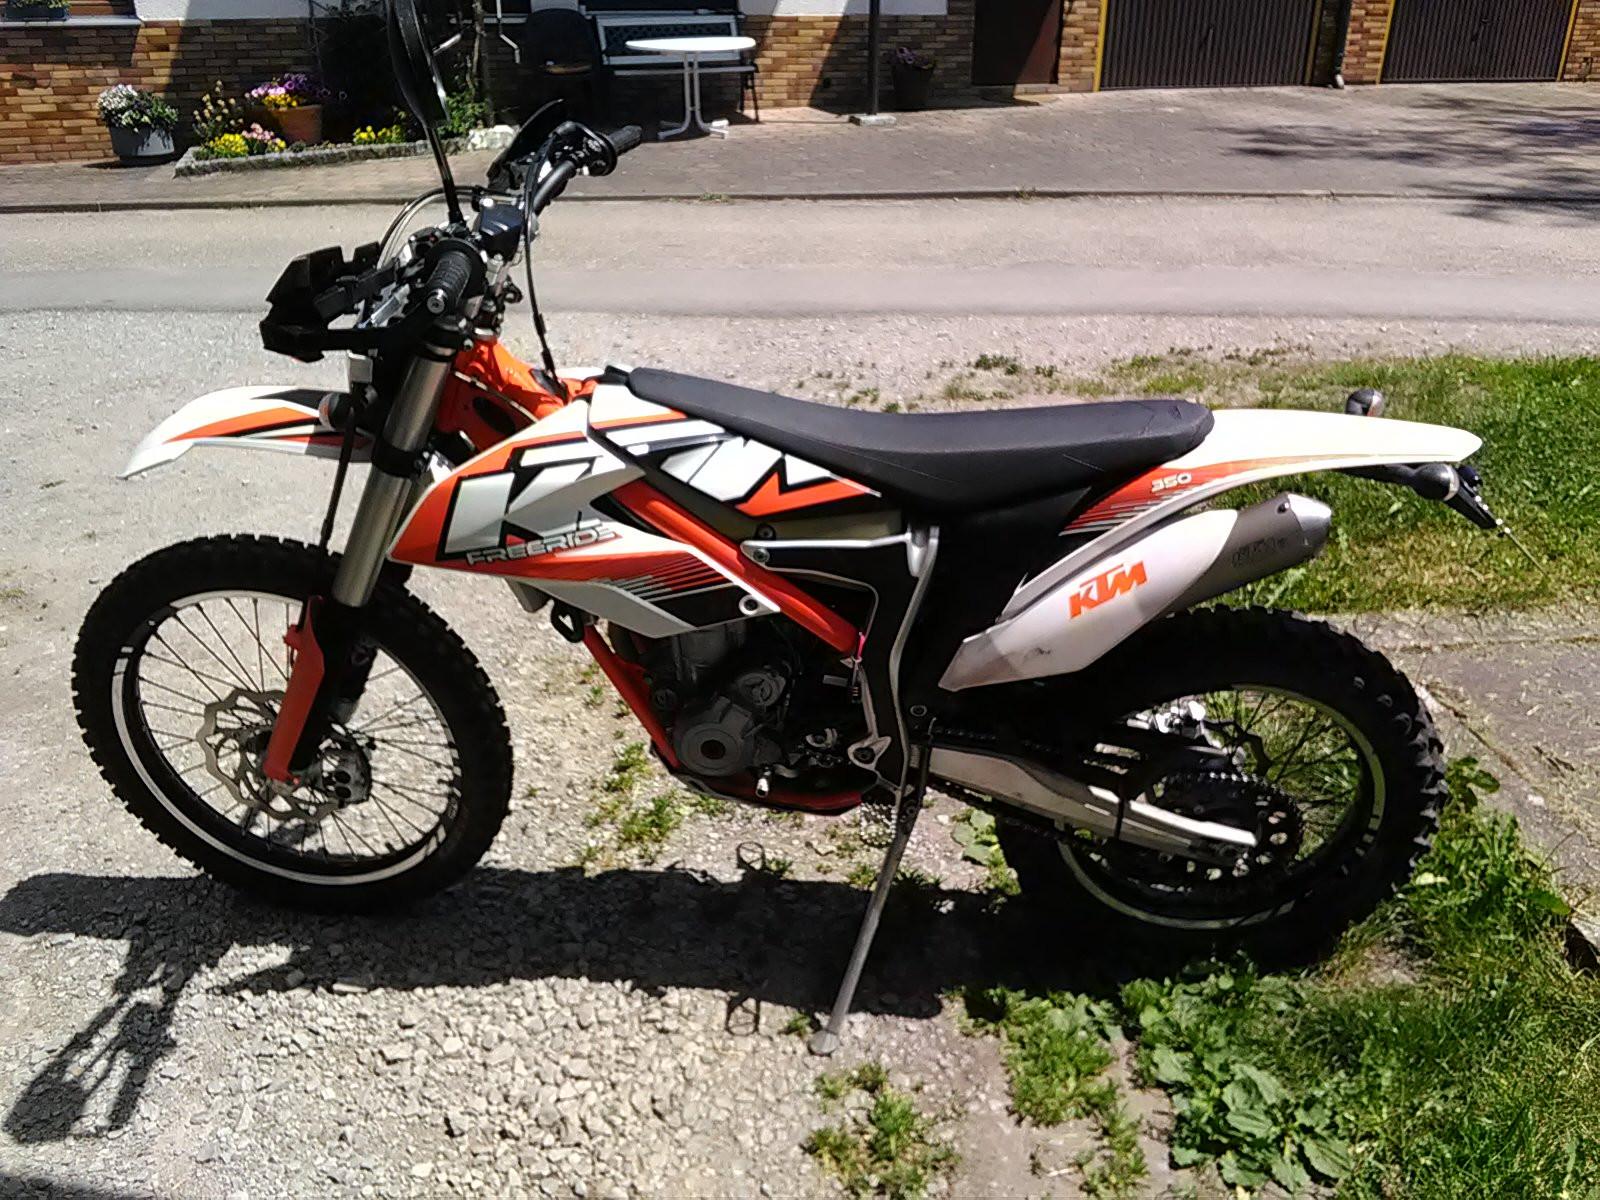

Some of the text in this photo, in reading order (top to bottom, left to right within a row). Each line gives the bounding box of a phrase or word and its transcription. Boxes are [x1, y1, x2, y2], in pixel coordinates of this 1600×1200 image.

[1150, 472, 1192, 493] 350
[466, 526, 622, 566] FREERIDE
[1070, 560, 1147, 618] KTM
